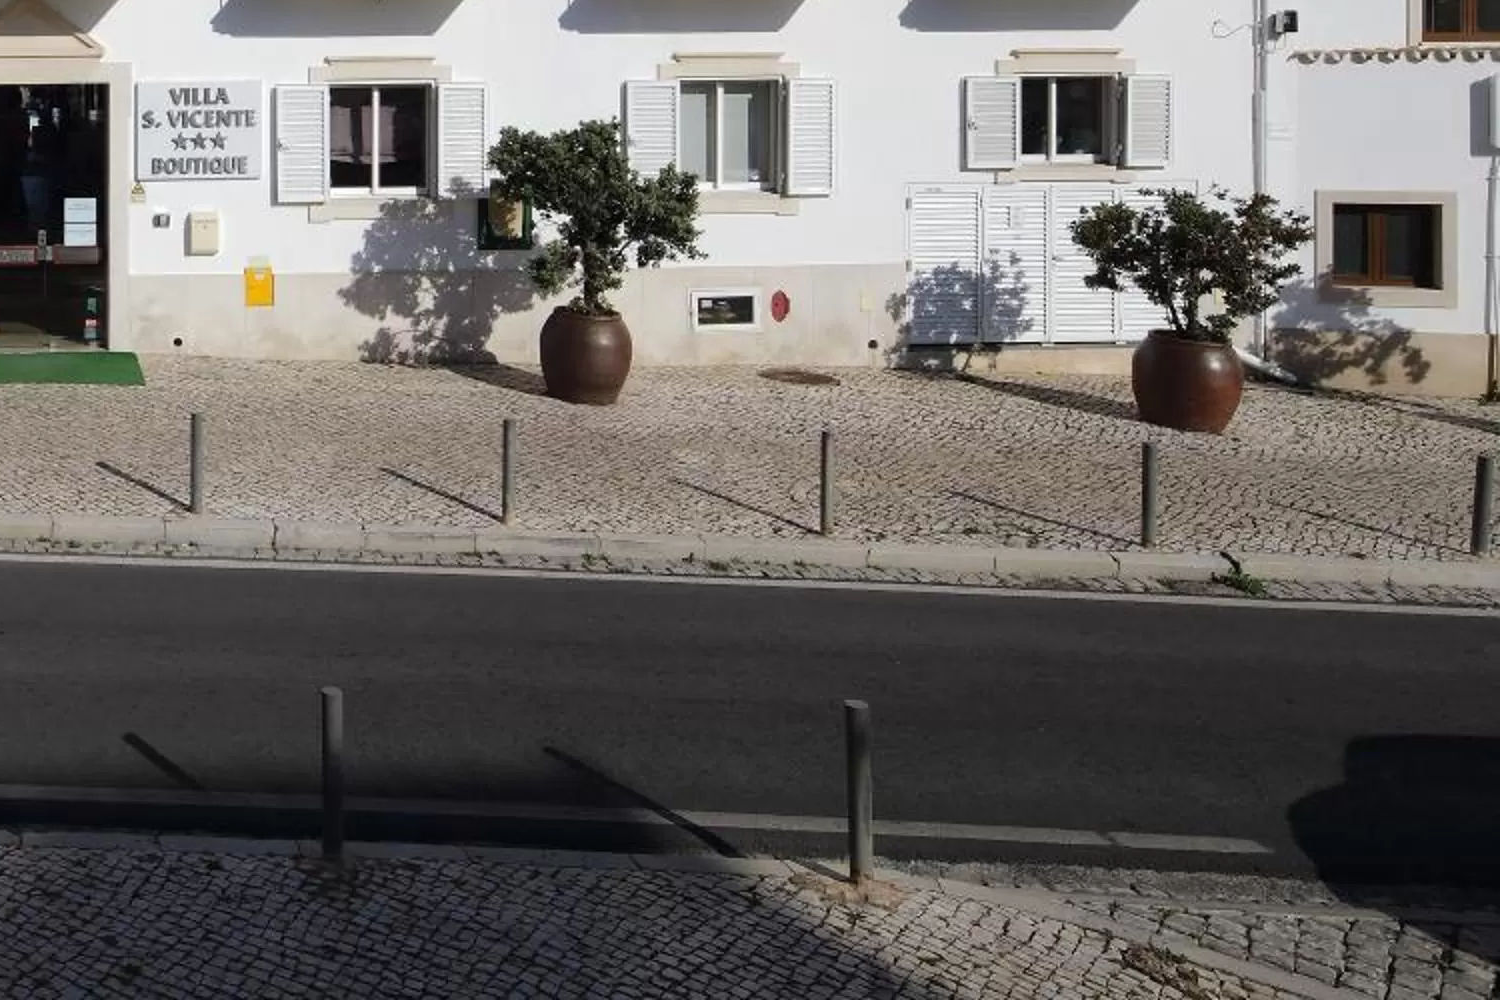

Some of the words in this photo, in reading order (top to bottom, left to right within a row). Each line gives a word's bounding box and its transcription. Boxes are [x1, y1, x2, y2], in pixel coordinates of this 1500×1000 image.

[169, 87, 230, 106] VILLA
[141, 110, 162, 129] S.
[166, 109, 257, 129] VICENTE
[151, 156, 249, 175] BOUTIQUE
